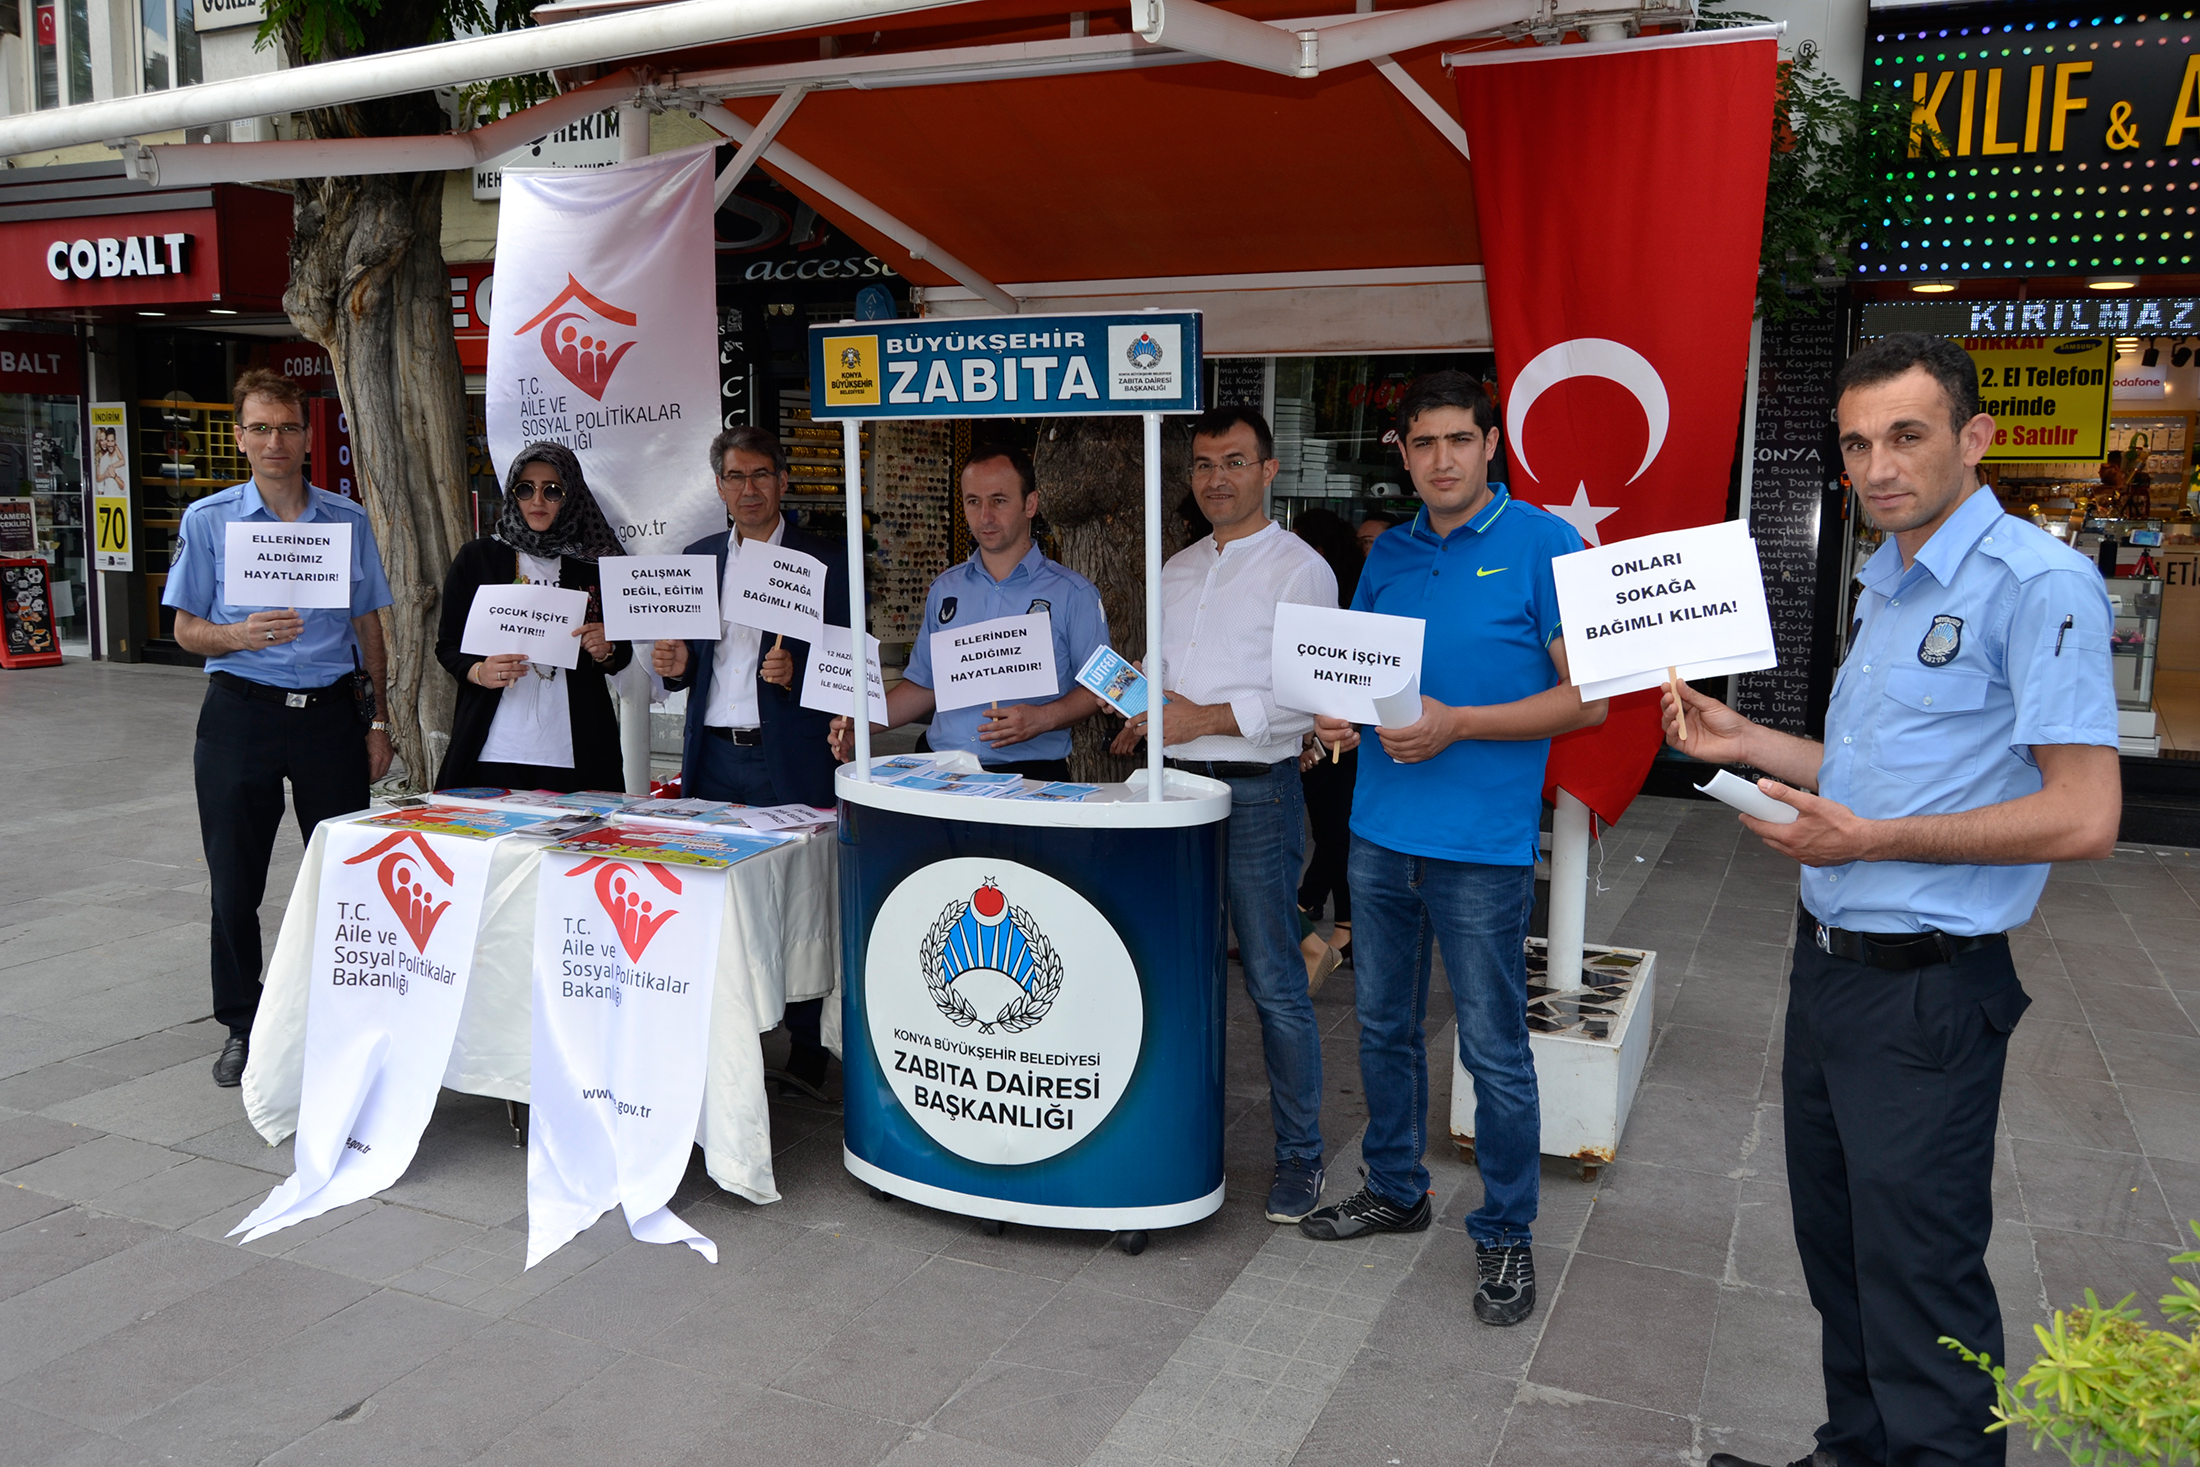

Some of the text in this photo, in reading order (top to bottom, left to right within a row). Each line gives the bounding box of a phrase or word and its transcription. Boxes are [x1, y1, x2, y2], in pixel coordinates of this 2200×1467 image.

[1906, 60, 2093, 159] KILIF
[2105, 100, 2140, 151] &
[47, 232, 186, 281] COBALT
[886, 327, 1086, 355] BÜYÜKŞEHİR
[831, 378, 873, 389] BÜYÜKŞEHİR
[841, 371, 862, 379] KONYA
[888, 355, 1100, 404] ZABITA
[1774, 371, 1819, 384] Konya
[2025, 366, 2104, 387] Telefon
[518, 377, 544, 396] T.C.
[1776, 384, 1825, 393] Mersin
[520, 396, 567, 418] AİLE VE
[522, 403, 682, 437] SOSYAL POLİTİKALAR
[2012, 425, 2079, 446] Satılır
[1771, 466, 1811, 475] Bonn
[99, 507, 126, 549] 70
[252, 535, 331, 546] ELLERİNDEN
[257, 552, 323, 563] ALDIĞIMIZ
[1611, 552, 1682, 577] ONLARI
[244, 570, 339, 582] HAYATLARIDIR!
[631, 568, 691, 579] ÇALIŞMAK
[773, 560, 811, 578] ONLARI
[622, 586, 704, 597] DEĞİL, EĞİTİM
[769, 577, 812, 597] SOKAĞA
[1615, 578, 1696, 605] SOKAĞA
[629, 603, 701, 614] İSTİYORUZ!!!
[743, 589, 791, 610] BAĞIMLI
[489, 606, 569, 625] ÇOCUK İŞÇİYE
[1586, 600, 1738, 640] BAĞIMLI KILMA!
[500, 623, 545, 637] HAYIR!!!
[954, 628, 1028, 647] ELLERİNDEN
[960, 646, 1022, 663] ALDIĞIMIZ
[1297, 643, 1401, 667] ÇOCUK İŞÇİYE
[818, 663, 853, 677] ÇOCUK
[951, 661, 1042, 683] HAYATLARIDIR!
[1314, 669, 1372, 687] HAYIR!!!
[337, 902, 370, 921] T.C.
[335, 924, 397, 945] Aile ve
[563, 918, 591, 935] T.C.
[562, 939, 616, 959] Aile ve
[334, 946, 457, 986] Sosyal Politikalar
[333, 968, 409, 996] Bakanlığı
[562, 960, 690, 995] Sosyal Politikalar
[562, 981, 622, 1007] Bakanlığı
[894, 1028, 1101, 1067] KONYA BÜYÜKŞEHİR BELEDİYESİ
[894, 1050, 1100, 1100] ZABITA DAİRESİ
[914, 1085, 1073, 1130] BAŞKANLIĞI
